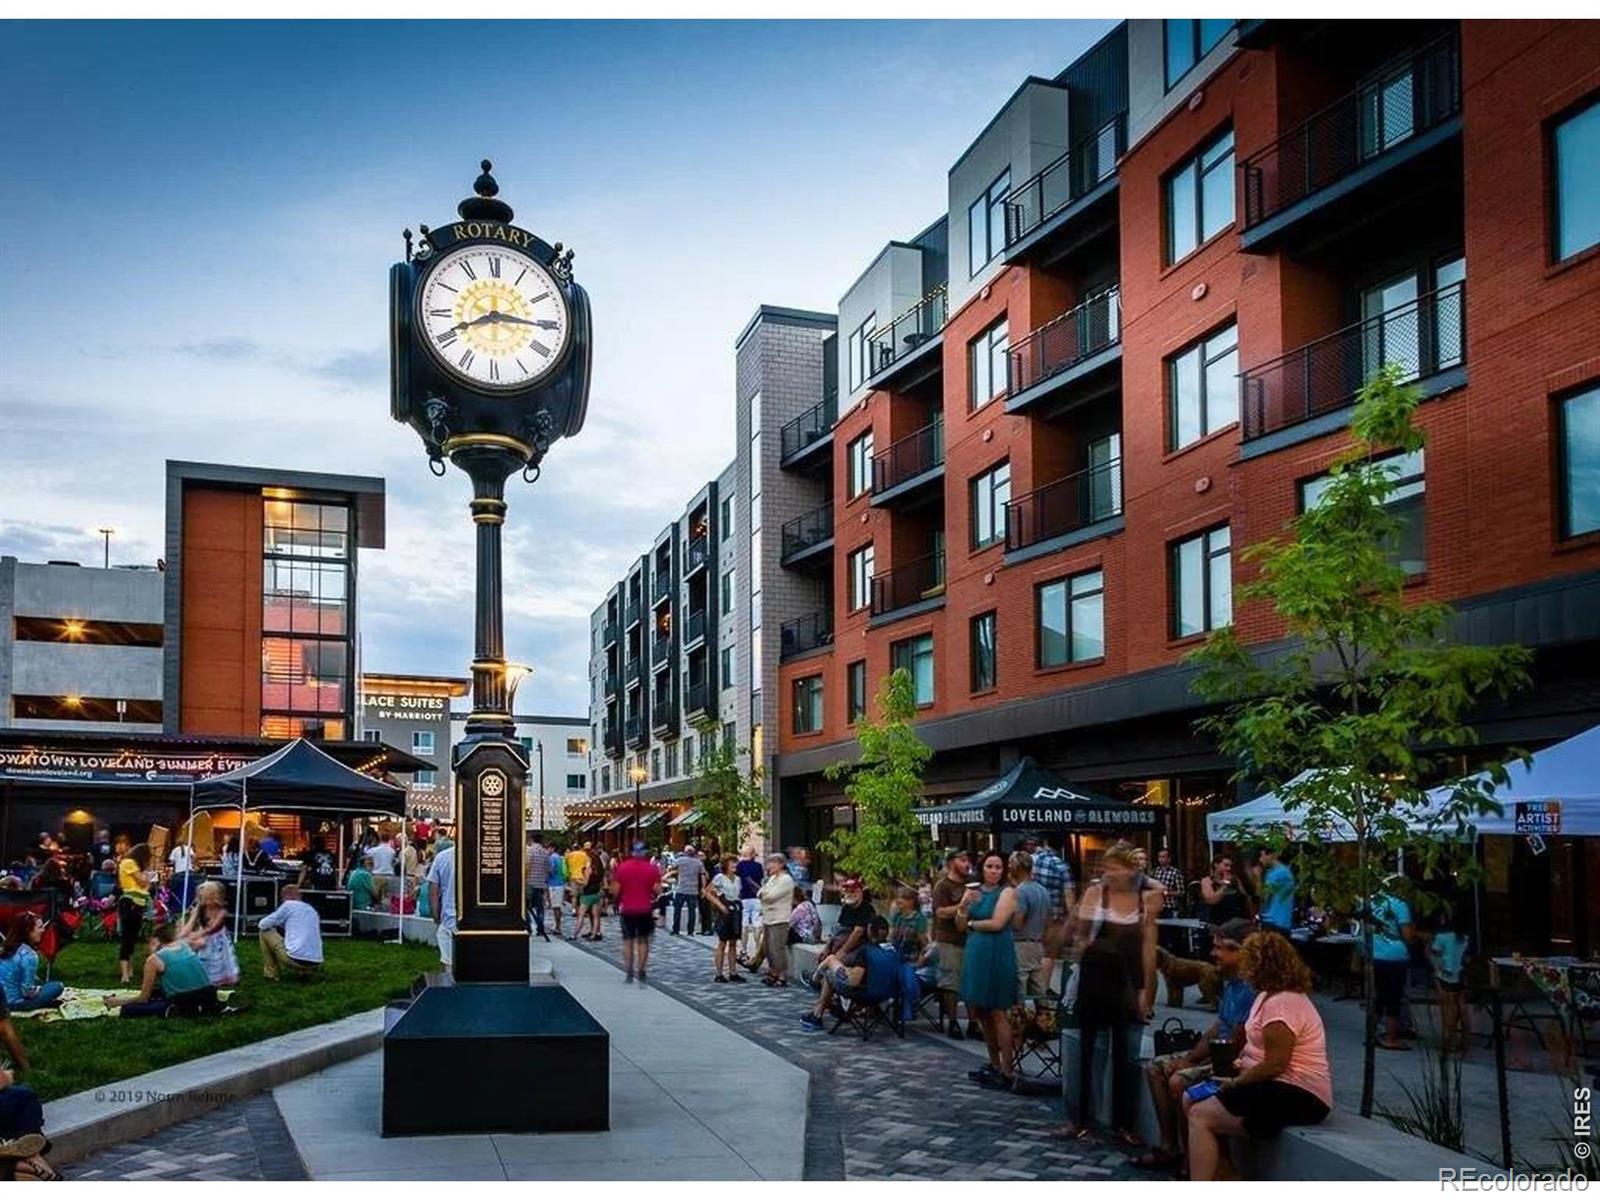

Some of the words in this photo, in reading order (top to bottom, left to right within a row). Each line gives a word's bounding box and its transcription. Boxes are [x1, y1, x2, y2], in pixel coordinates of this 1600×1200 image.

[453, 223, 535, 248] ROTARY
[400, 697, 443, 709] SUITES
[379, 711, 391, 719] BY
[394, 712, 443, 721] MARRIOTT
[80, 757, 154, 769] LOVELAND
[159, 760, 213, 770] SUMMER
[1003, 809, 1072, 822] LOVELAND
[1088, 809, 1156, 824] ALEWORKS
[1517, 813, 1559, 824] ARTIST
